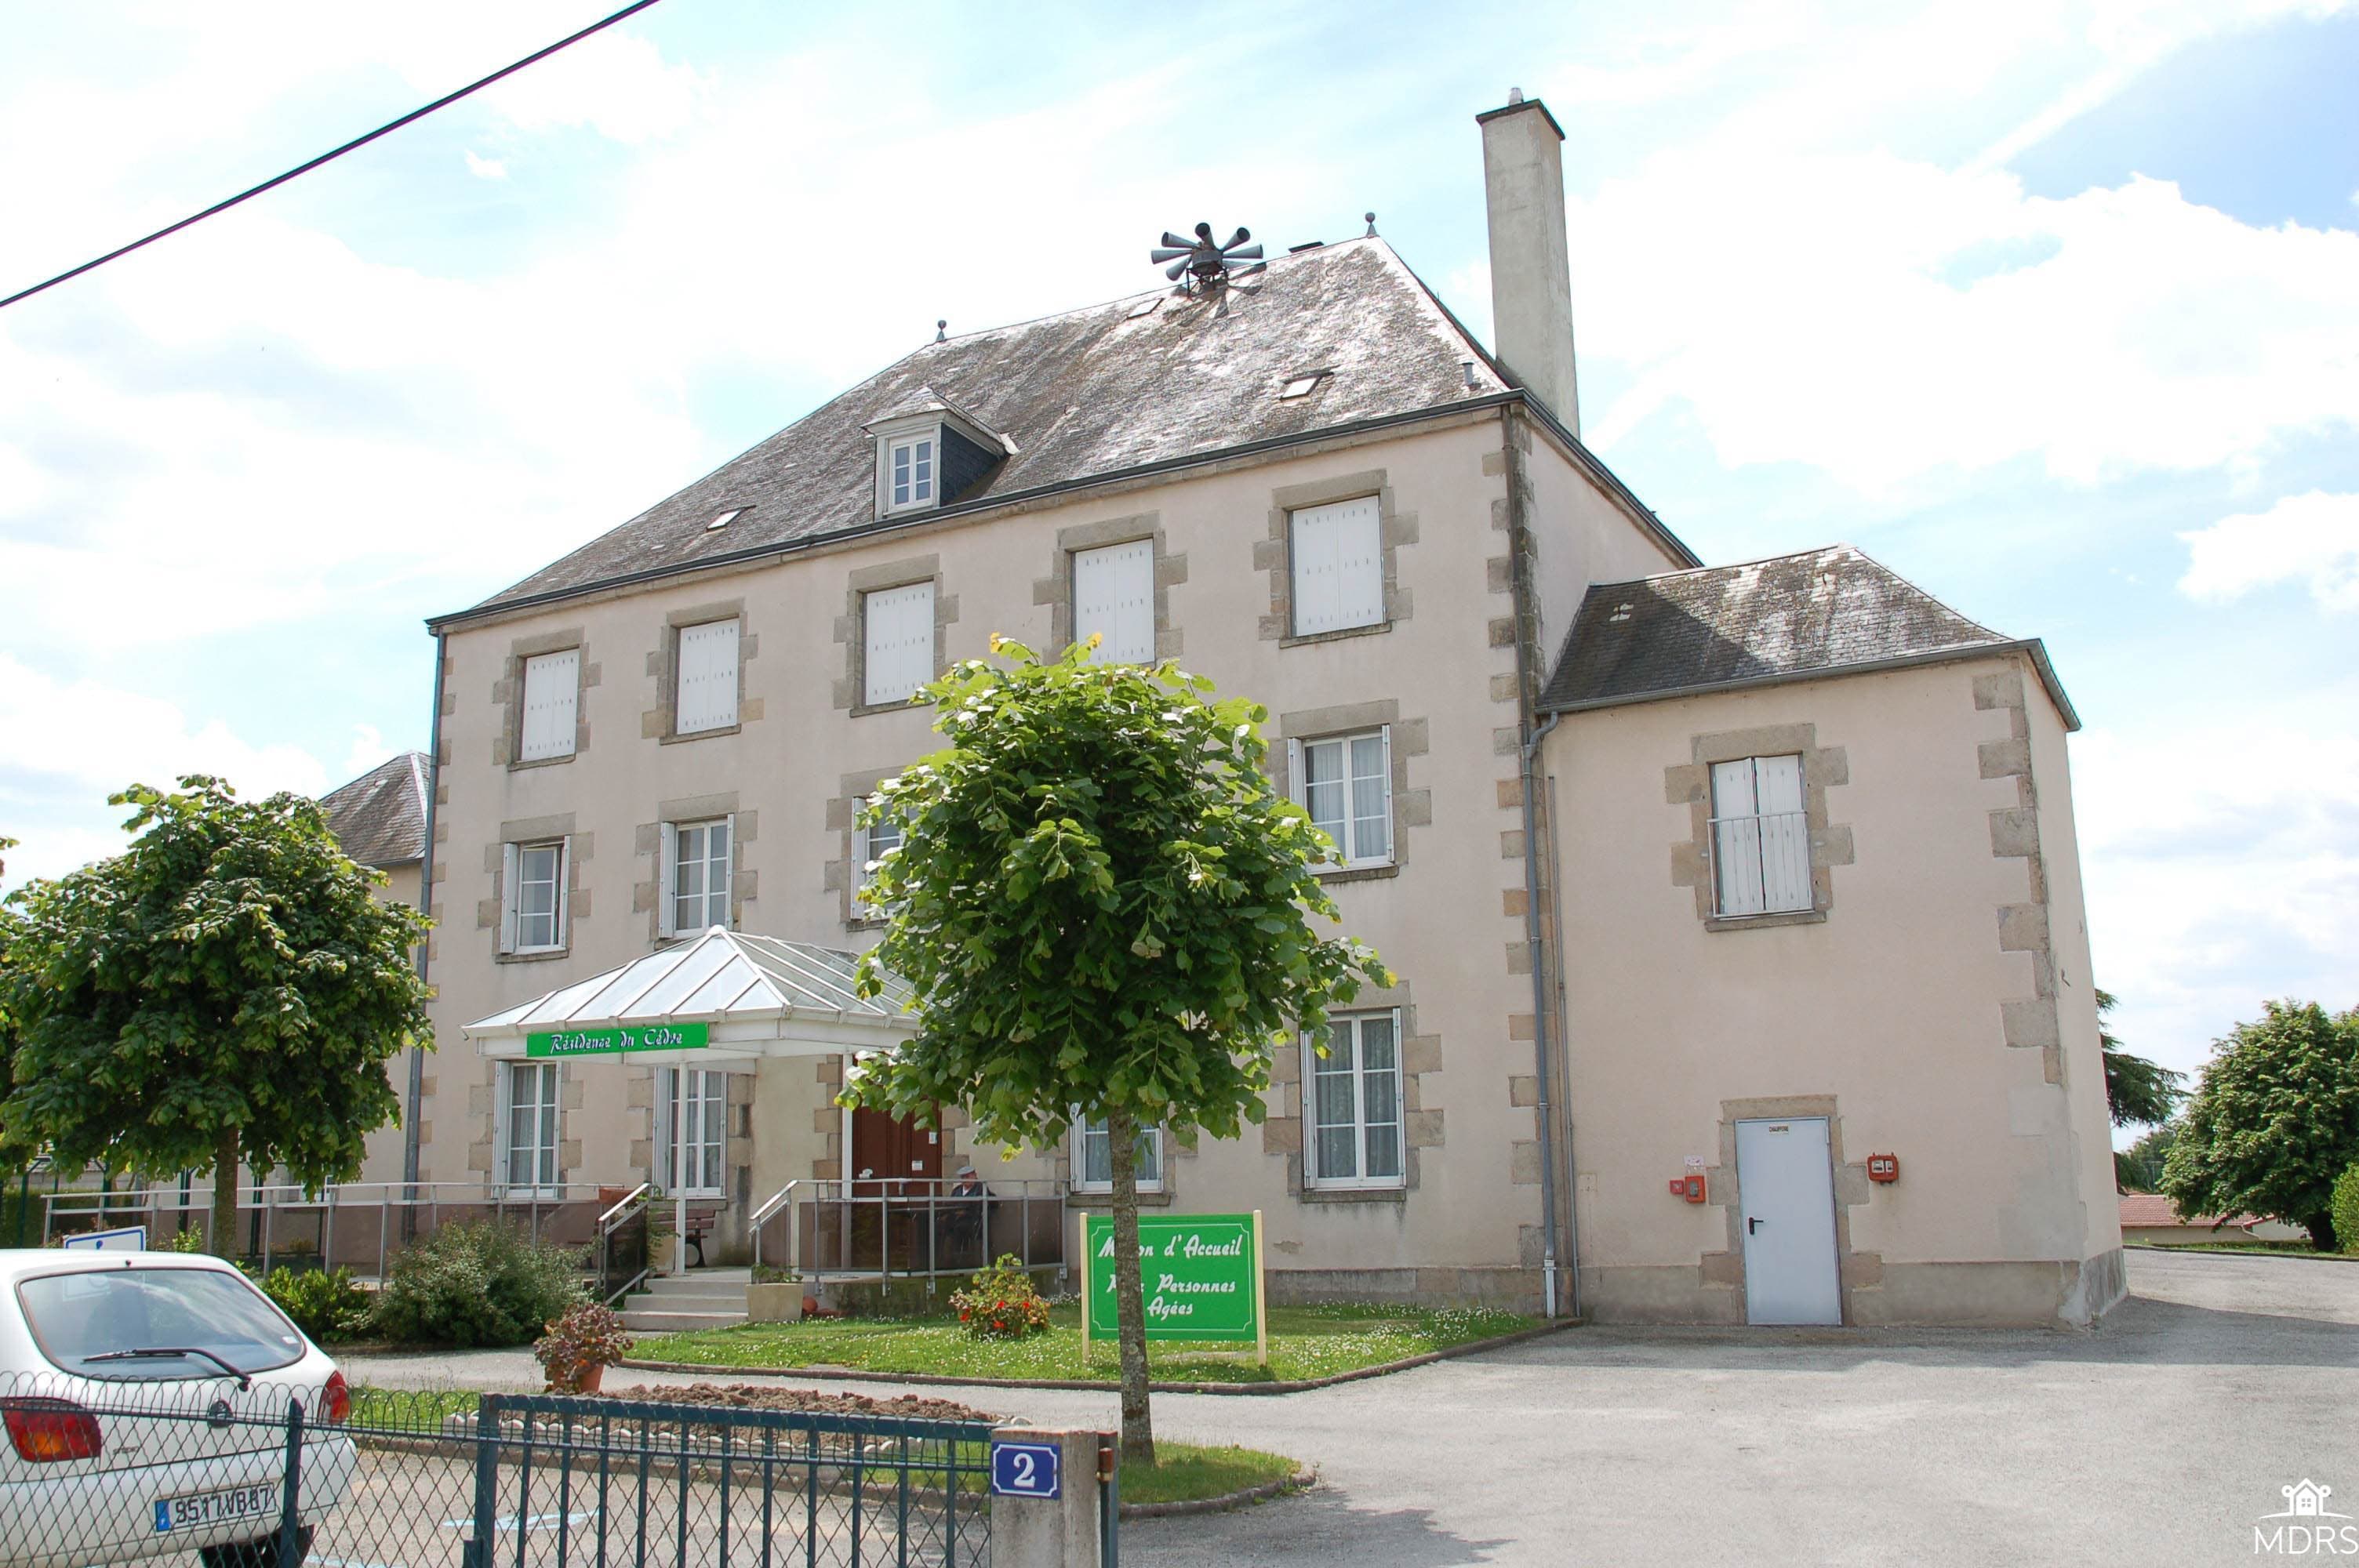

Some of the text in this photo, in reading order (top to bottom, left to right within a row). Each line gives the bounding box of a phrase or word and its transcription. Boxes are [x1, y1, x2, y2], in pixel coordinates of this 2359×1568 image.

[549, 1033, 611, 1054] Résidence
[620, 1031, 634, 1048] du
[1098, 1236, 1154, 1258] Mon
[1155, 1273, 1236, 1293] Personnes
[1147, 1295, 1194, 1321] Agées
[1013, 1453, 1036, 1488] 2
